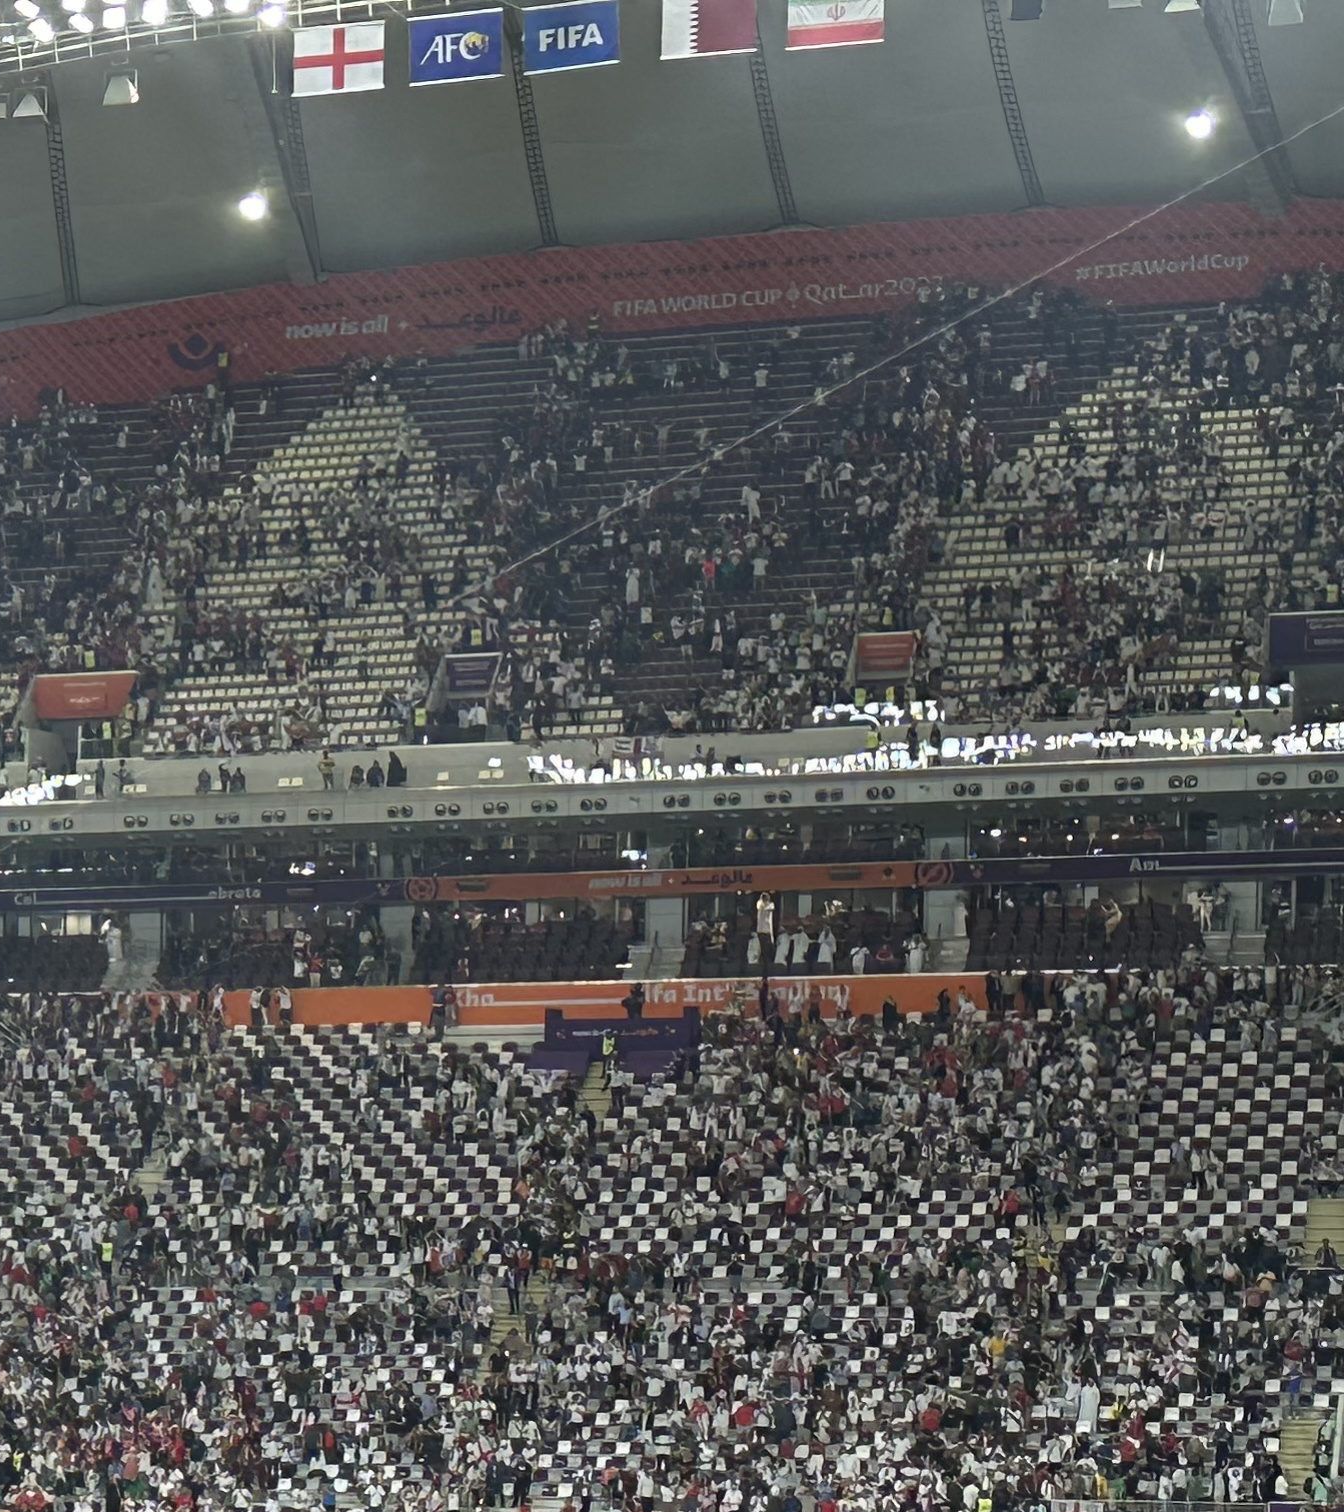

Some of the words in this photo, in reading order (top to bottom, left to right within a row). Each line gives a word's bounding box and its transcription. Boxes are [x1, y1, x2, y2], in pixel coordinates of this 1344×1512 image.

[420, 31, 488, 66] AFC
[538, 22, 604, 52] FIFA
[1075, 253, 1250, 281] #FIFAWorldCup
[612, 299, 658, 317] FIFA
[661, 293, 737, 315] WORLD
[741, 287, 783, 308] CUP
[285, 321, 337, 340] now
[339, 316, 358, 335] is
[361, 314, 389, 335] all
